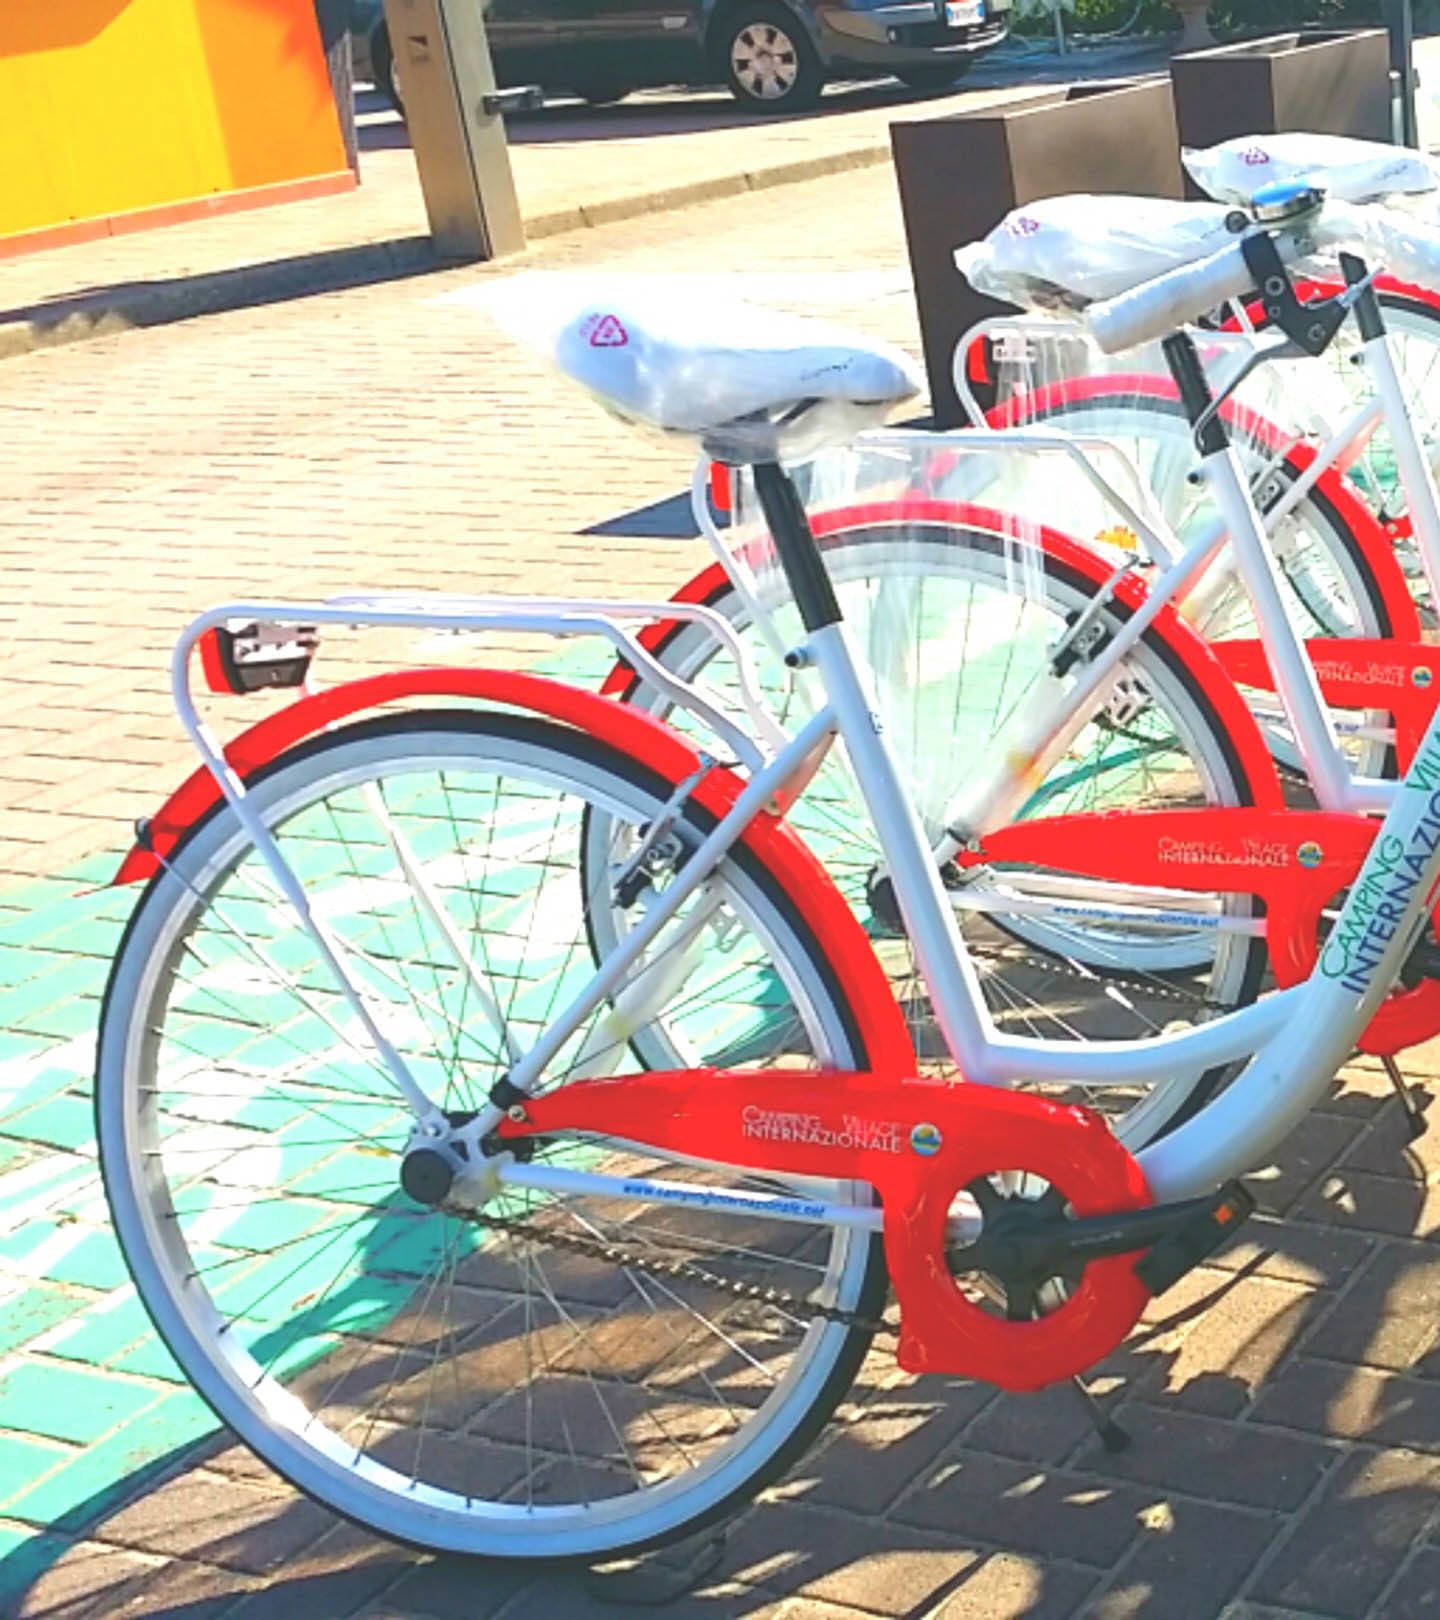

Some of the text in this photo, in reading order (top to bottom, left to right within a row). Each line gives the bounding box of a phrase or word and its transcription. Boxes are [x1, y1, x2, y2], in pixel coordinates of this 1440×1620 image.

[1321, 834, 1404, 978] CAMPING
[742, 1105, 900, 1138] CAMPING VILLAGE
[742, 1124, 902, 1153] INTERNAZIONALE
